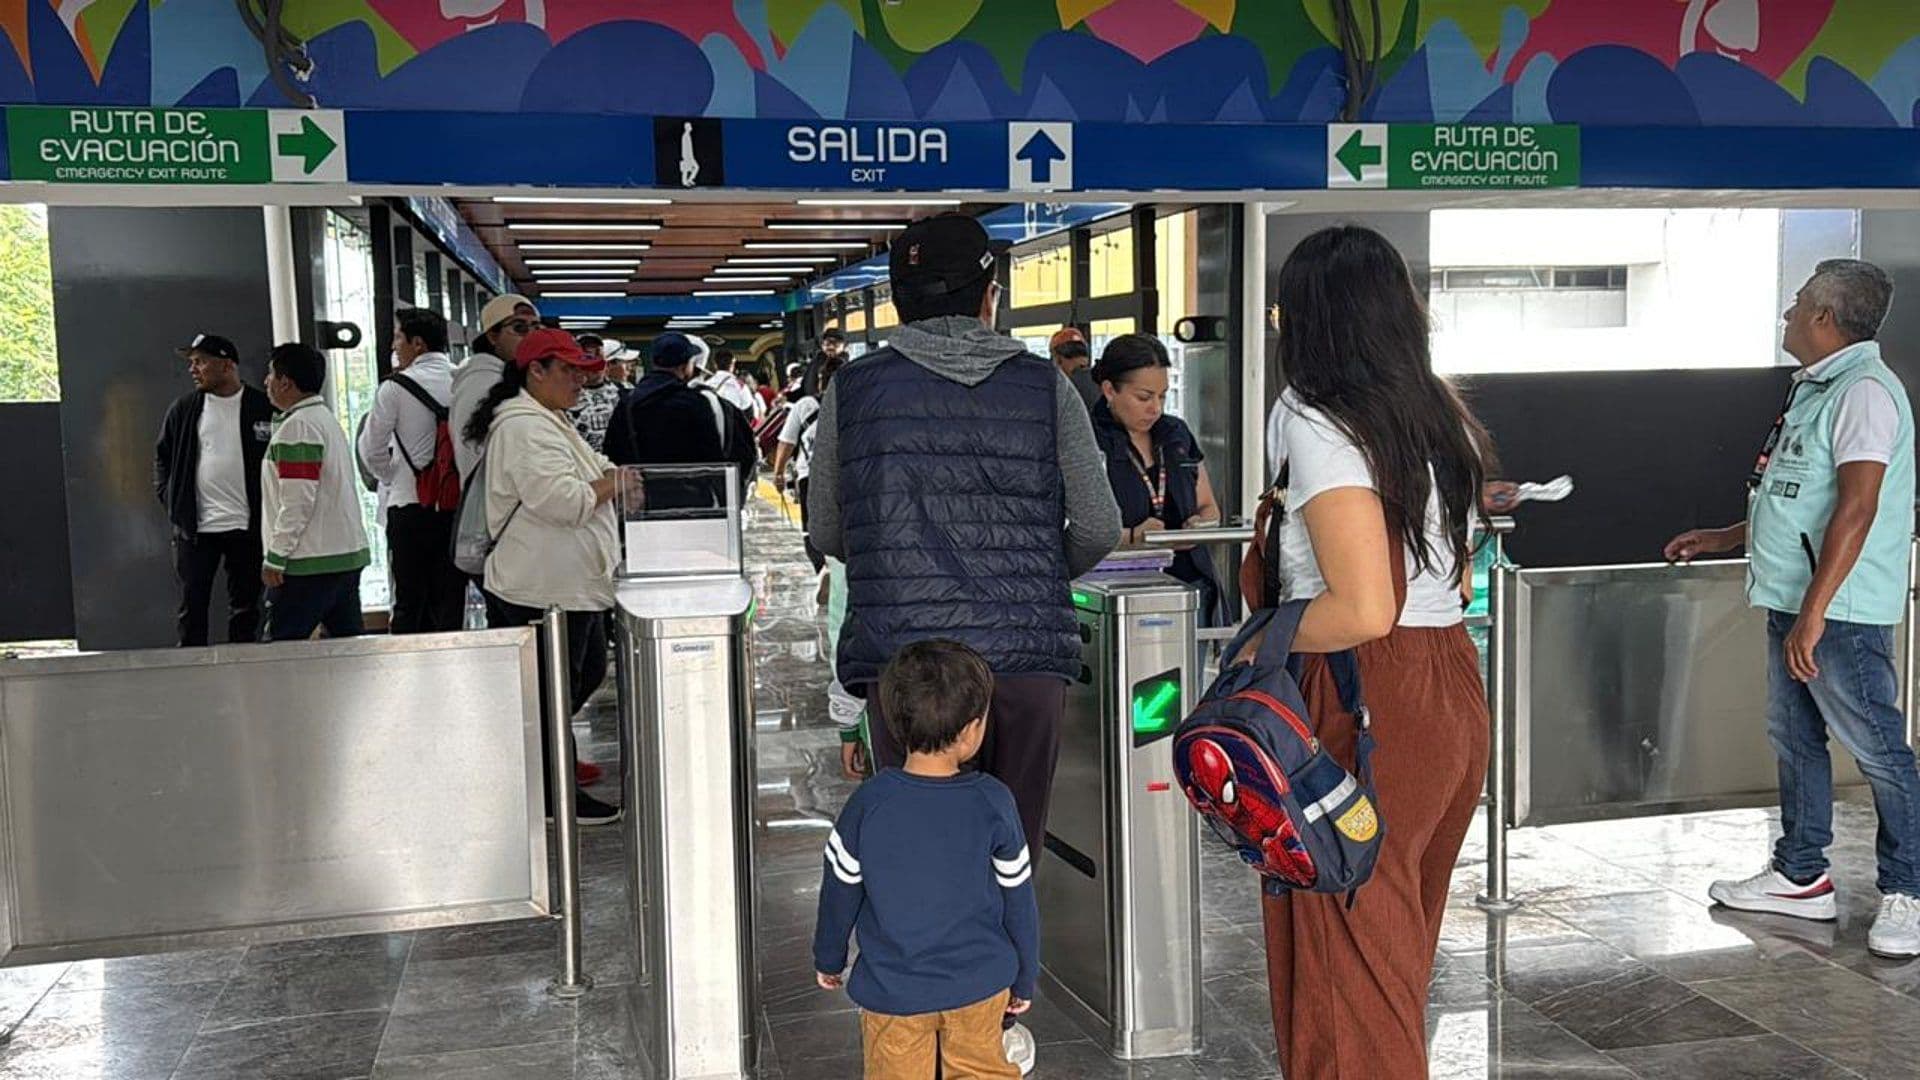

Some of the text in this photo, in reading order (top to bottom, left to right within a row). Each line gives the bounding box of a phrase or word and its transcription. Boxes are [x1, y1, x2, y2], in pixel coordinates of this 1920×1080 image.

[70, 110, 206, 134] RUTA DE
[787, 126, 948, 163] SALIDA
[1434, 126, 1536, 147] RUTA DE
[39, 134, 240, 163] EVACUACIÓN
[1411, 145, 1558, 171] EVACUACIÓN
[55, 167, 227, 179] EMERGENCY EXIT ROUTE
[851, 168, 886, 182] EXIT
[1421, 175, 1548, 185] EMERGENCY EXIT ROUTE
